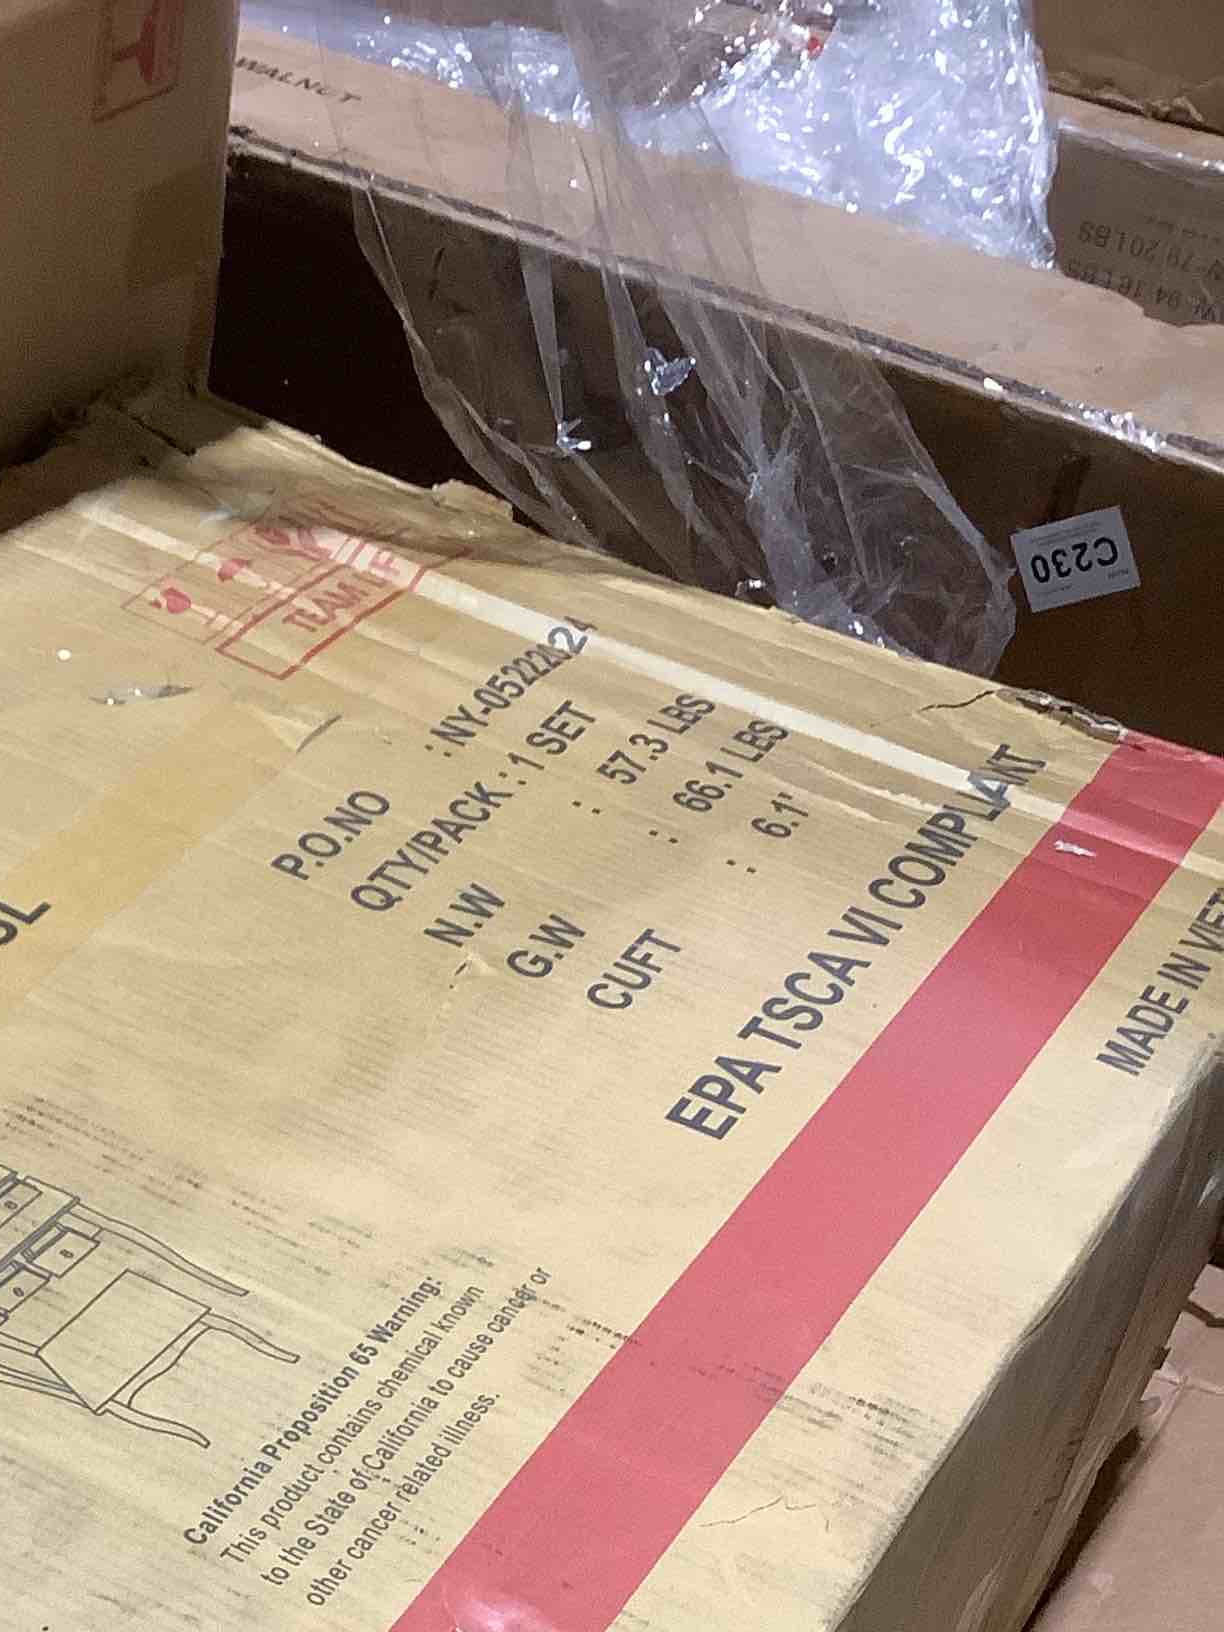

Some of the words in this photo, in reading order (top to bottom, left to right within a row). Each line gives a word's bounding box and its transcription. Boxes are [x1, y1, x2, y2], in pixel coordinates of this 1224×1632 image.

[1031, 537, 1118, 583] C230
[507, 751, 545, 771] 1
[525, 699, 596, 755] SET
[271, 790, 390, 880] P.O.NO
[350, 781, 513, 912] QTY/PACK
[423, 882, 505, 948] N.W
[596, 733, 669, 785] 57.3
[646, 693, 716, 736] LBS
[506, 913, 587, 979] G.W
[673, 760, 744, 813] 66.1
[720, 719, 789, 763] LBS
[586, 928, 682, 1010] CUFT
[665, 1055, 782, 1141] EPA
[737, 951, 872, 1050] TSCA
[827, 906, 904, 947] VI
[1096, 985, 1190, 1076] MADE
[1157, 952, 1212, 991] IN
[183, 1460, 273, 1545] California
[260, 1365, 361, 1462] Proposition
[349, 1343, 379, 1366] 65
[366, 1276, 444, 1344] Warning:
[220, 1527, 267, 1563] This
[260, 1463, 325, 1531] product
[317, 1398, 383, 1465] contains
[376, 1330, 443, 1399] chemical
[430, 1285, 485, 1334] known
[260, 1566, 290, 1586] to
[278, 1536, 317, 1567] the
[304, 1490, 356, 1537] State
[349, 1468, 373, 1491] of
[361, 1395, 439, 1471] California
[429, 1378, 455, 1397] to
[447, 1333, 494, 1379] cause
[487, 1283, 537, 1334] cancer
[530, 1266, 551, 1286] or
[306, 1559, 353, 1607] other
[347, 1501, 402, 1560] cancer
[395, 1442, 452, 1503] related
[439, 1394, 500, 1446] illness.
